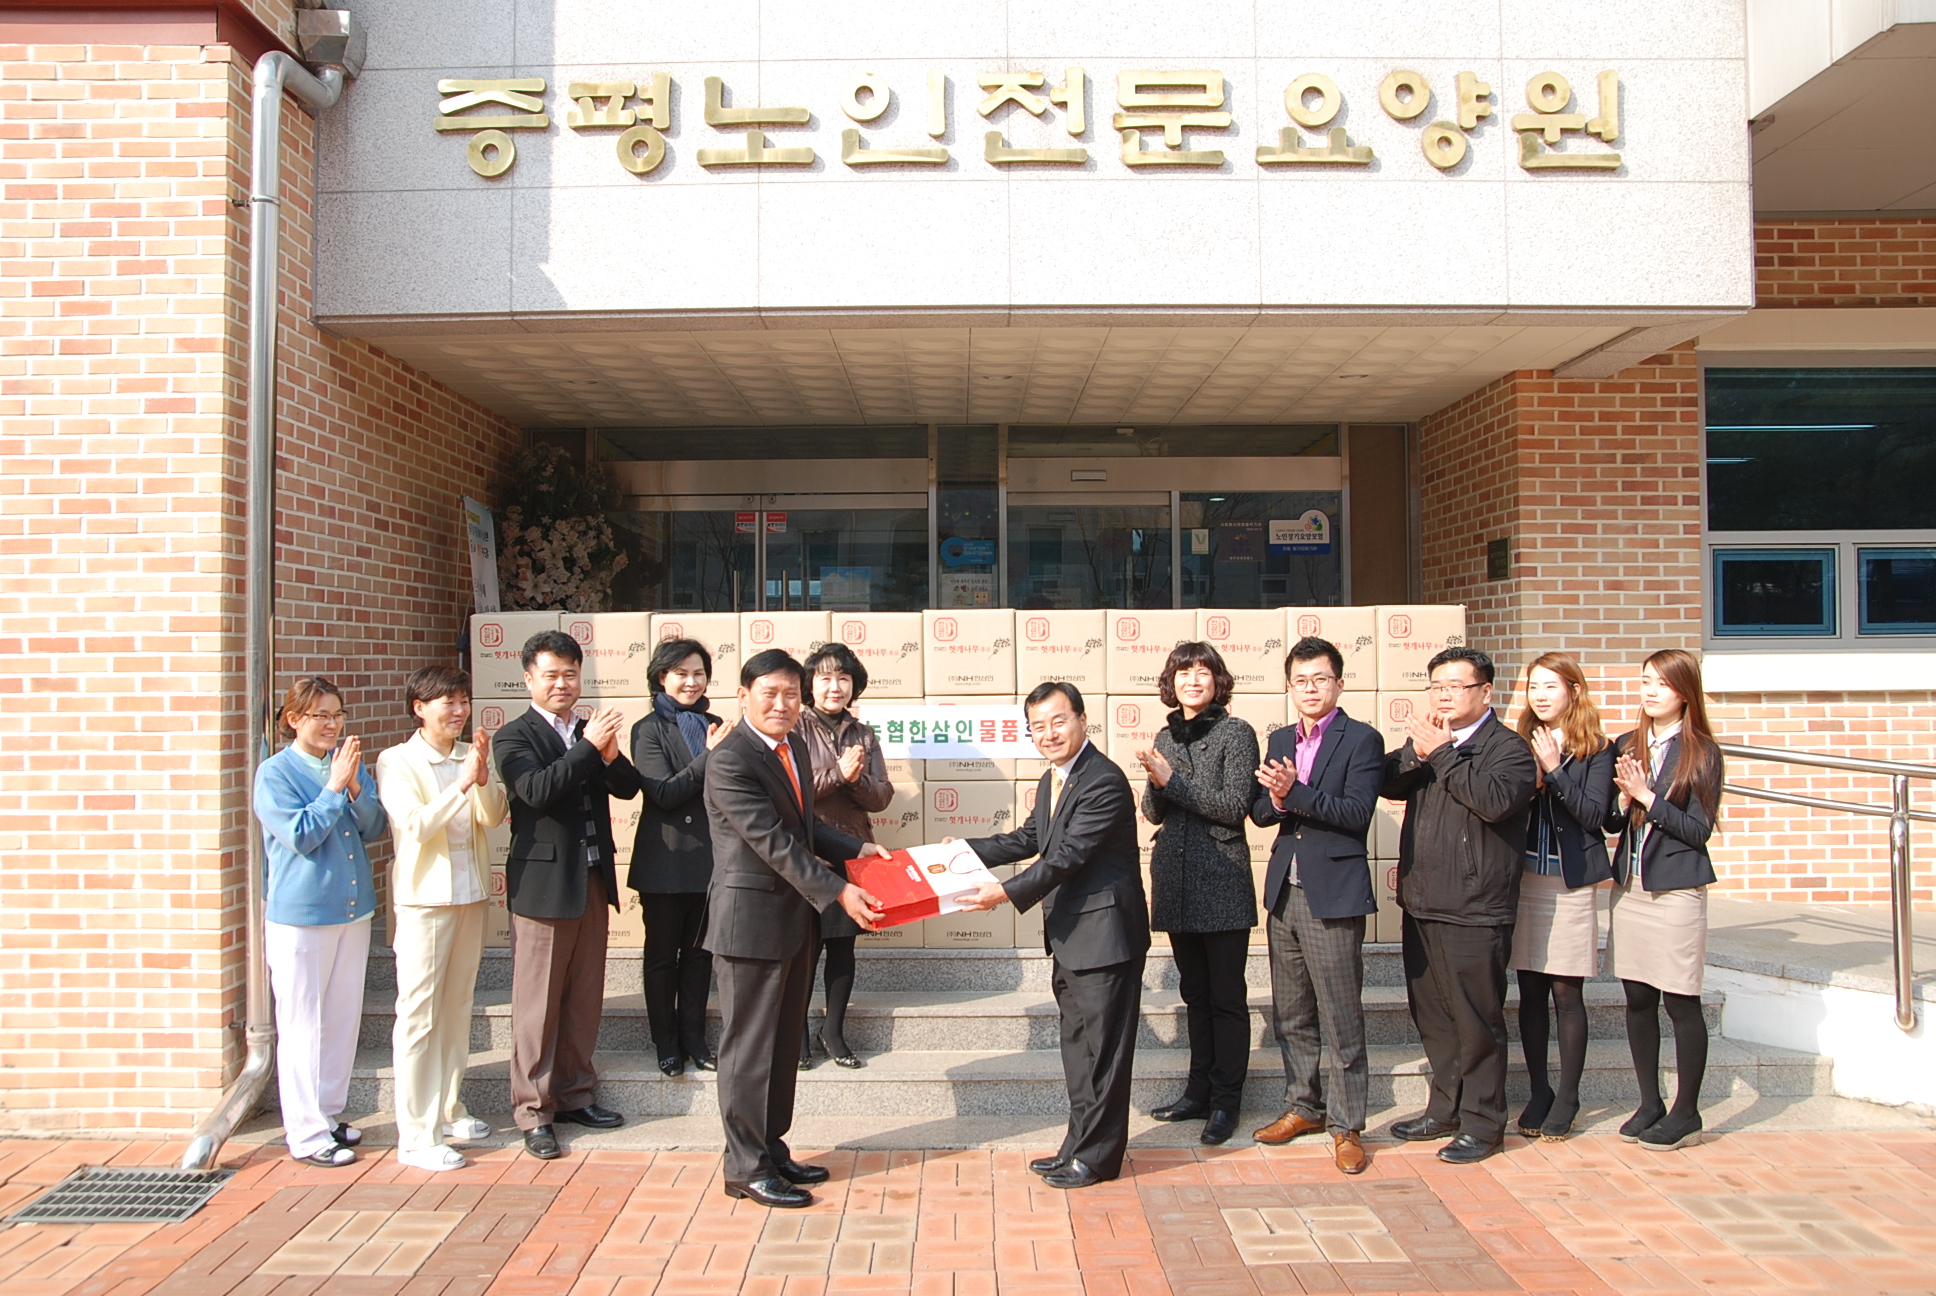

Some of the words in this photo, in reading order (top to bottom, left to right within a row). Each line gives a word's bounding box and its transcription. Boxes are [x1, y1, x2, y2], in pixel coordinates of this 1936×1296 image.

[434, 66, 1623, 178] 증평노인전문요양원
[1276, 532, 1324, 541] 노인장기요양보험
[949, 645, 979, 654] 헛개나무
[1041, 645, 1071, 654] 헛개나무
[1131, 645, 1161, 654] 헛개나무
[1221, 644, 1251, 653] 헛개나무
[1403, 642, 1432, 650] 헛개나무
[980, 720, 1018, 743] 물품
[949, 816, 979, 824] 헛개나무
